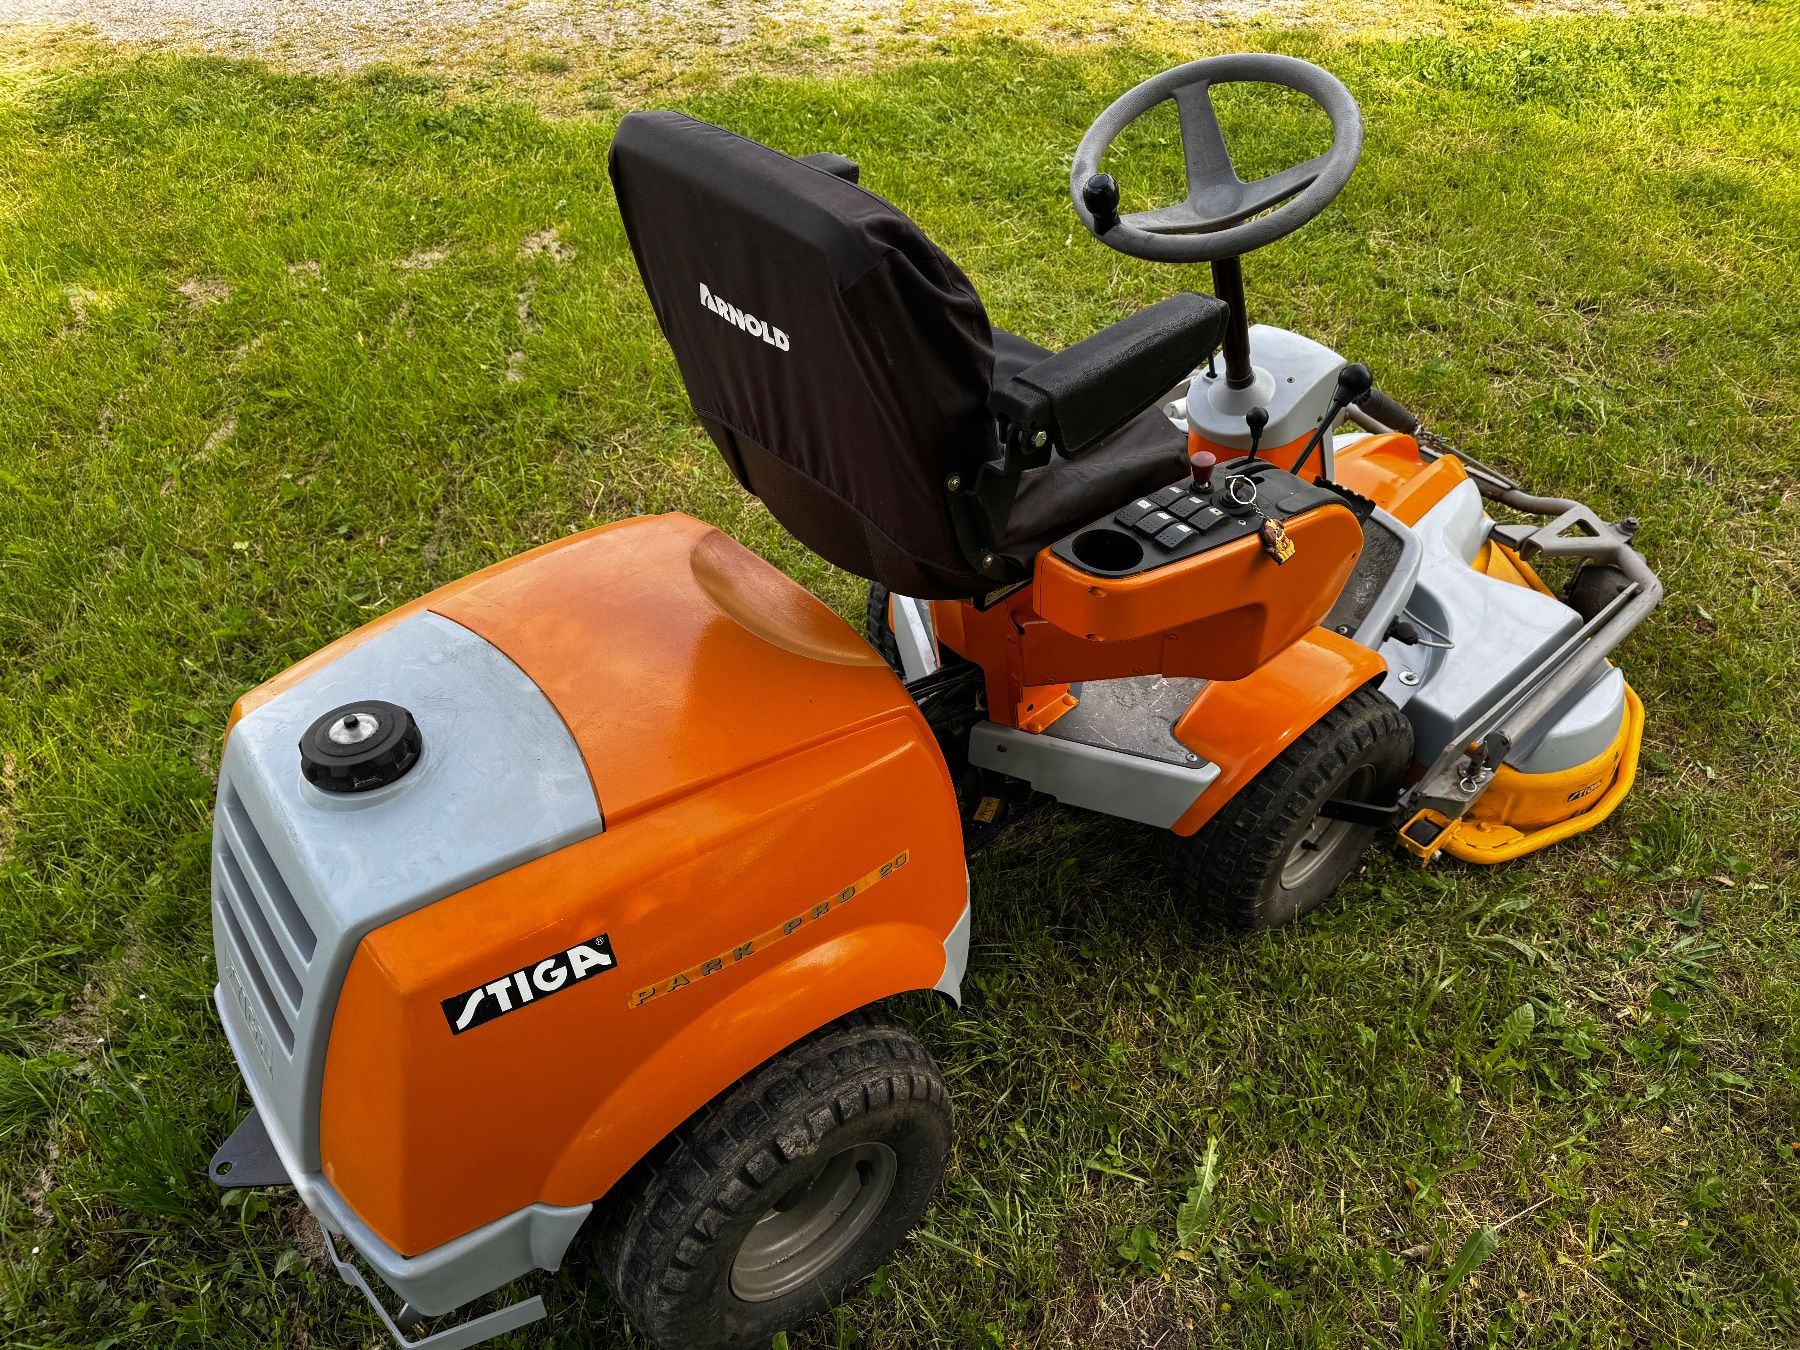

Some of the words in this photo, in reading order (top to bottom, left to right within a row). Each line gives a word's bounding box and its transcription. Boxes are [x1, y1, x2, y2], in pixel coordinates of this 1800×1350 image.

[699, 282, 790, 352] ARNOLD
[1568, 781, 1602, 802] STIG
[634, 941, 756, 1007] PARK
[782, 886, 856, 936] PRO
[879, 853, 907, 879] 20
[455, 944, 612, 1031] STIGA
